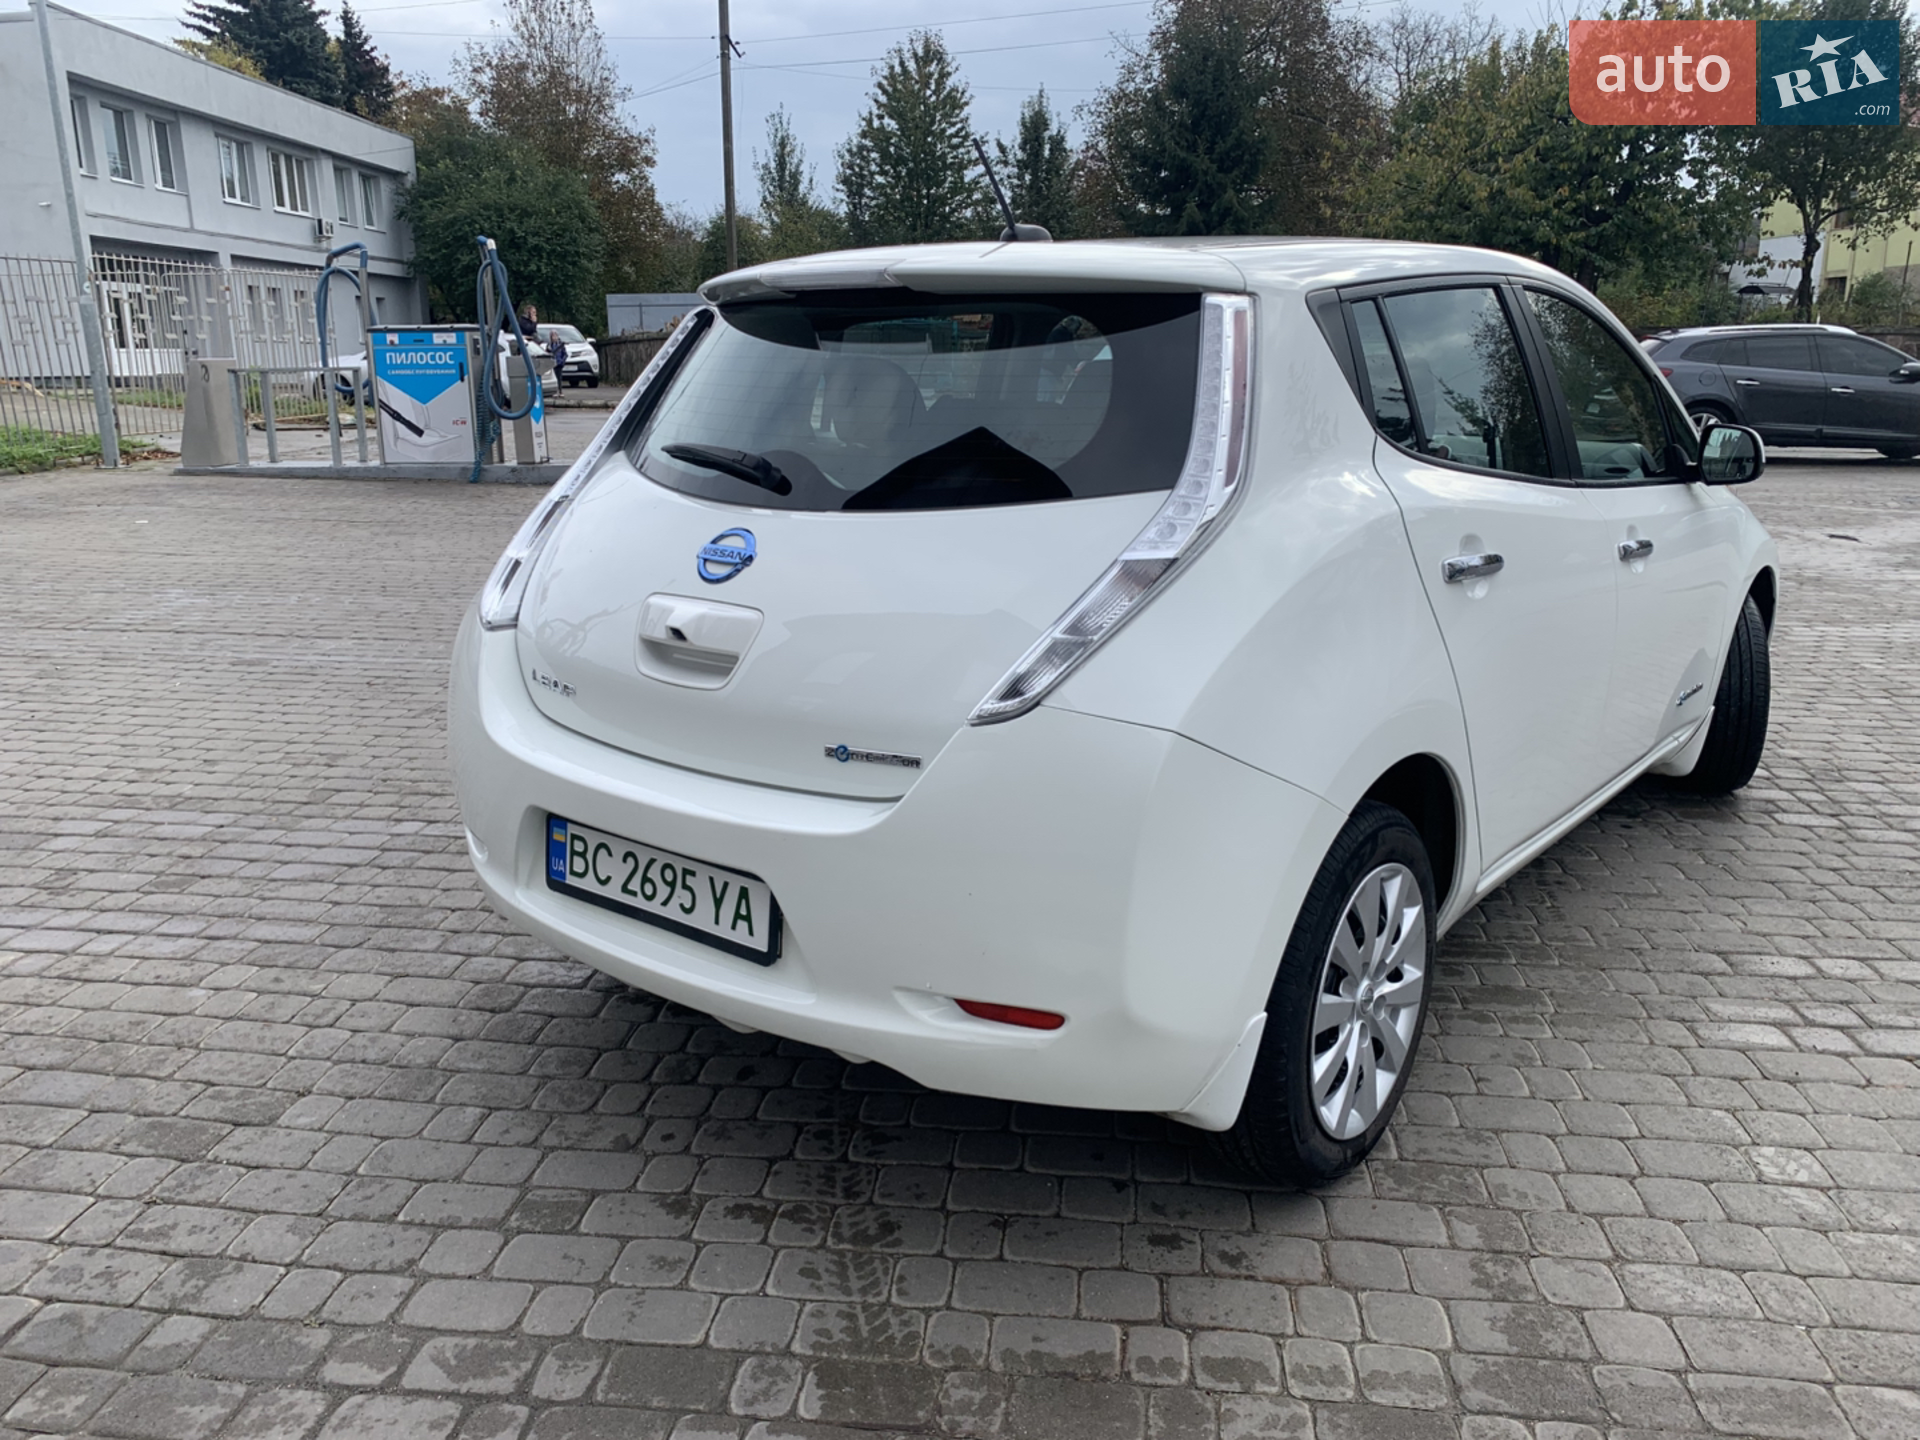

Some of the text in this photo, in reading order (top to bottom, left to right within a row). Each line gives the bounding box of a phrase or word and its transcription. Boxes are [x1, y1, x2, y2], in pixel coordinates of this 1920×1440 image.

[386, 351, 455, 365] ПИЛОСОС
[700, 546, 747, 562] NISSAN
[551, 856, 565, 874] UA
[568, 832, 755, 938] BC 2695 YA
